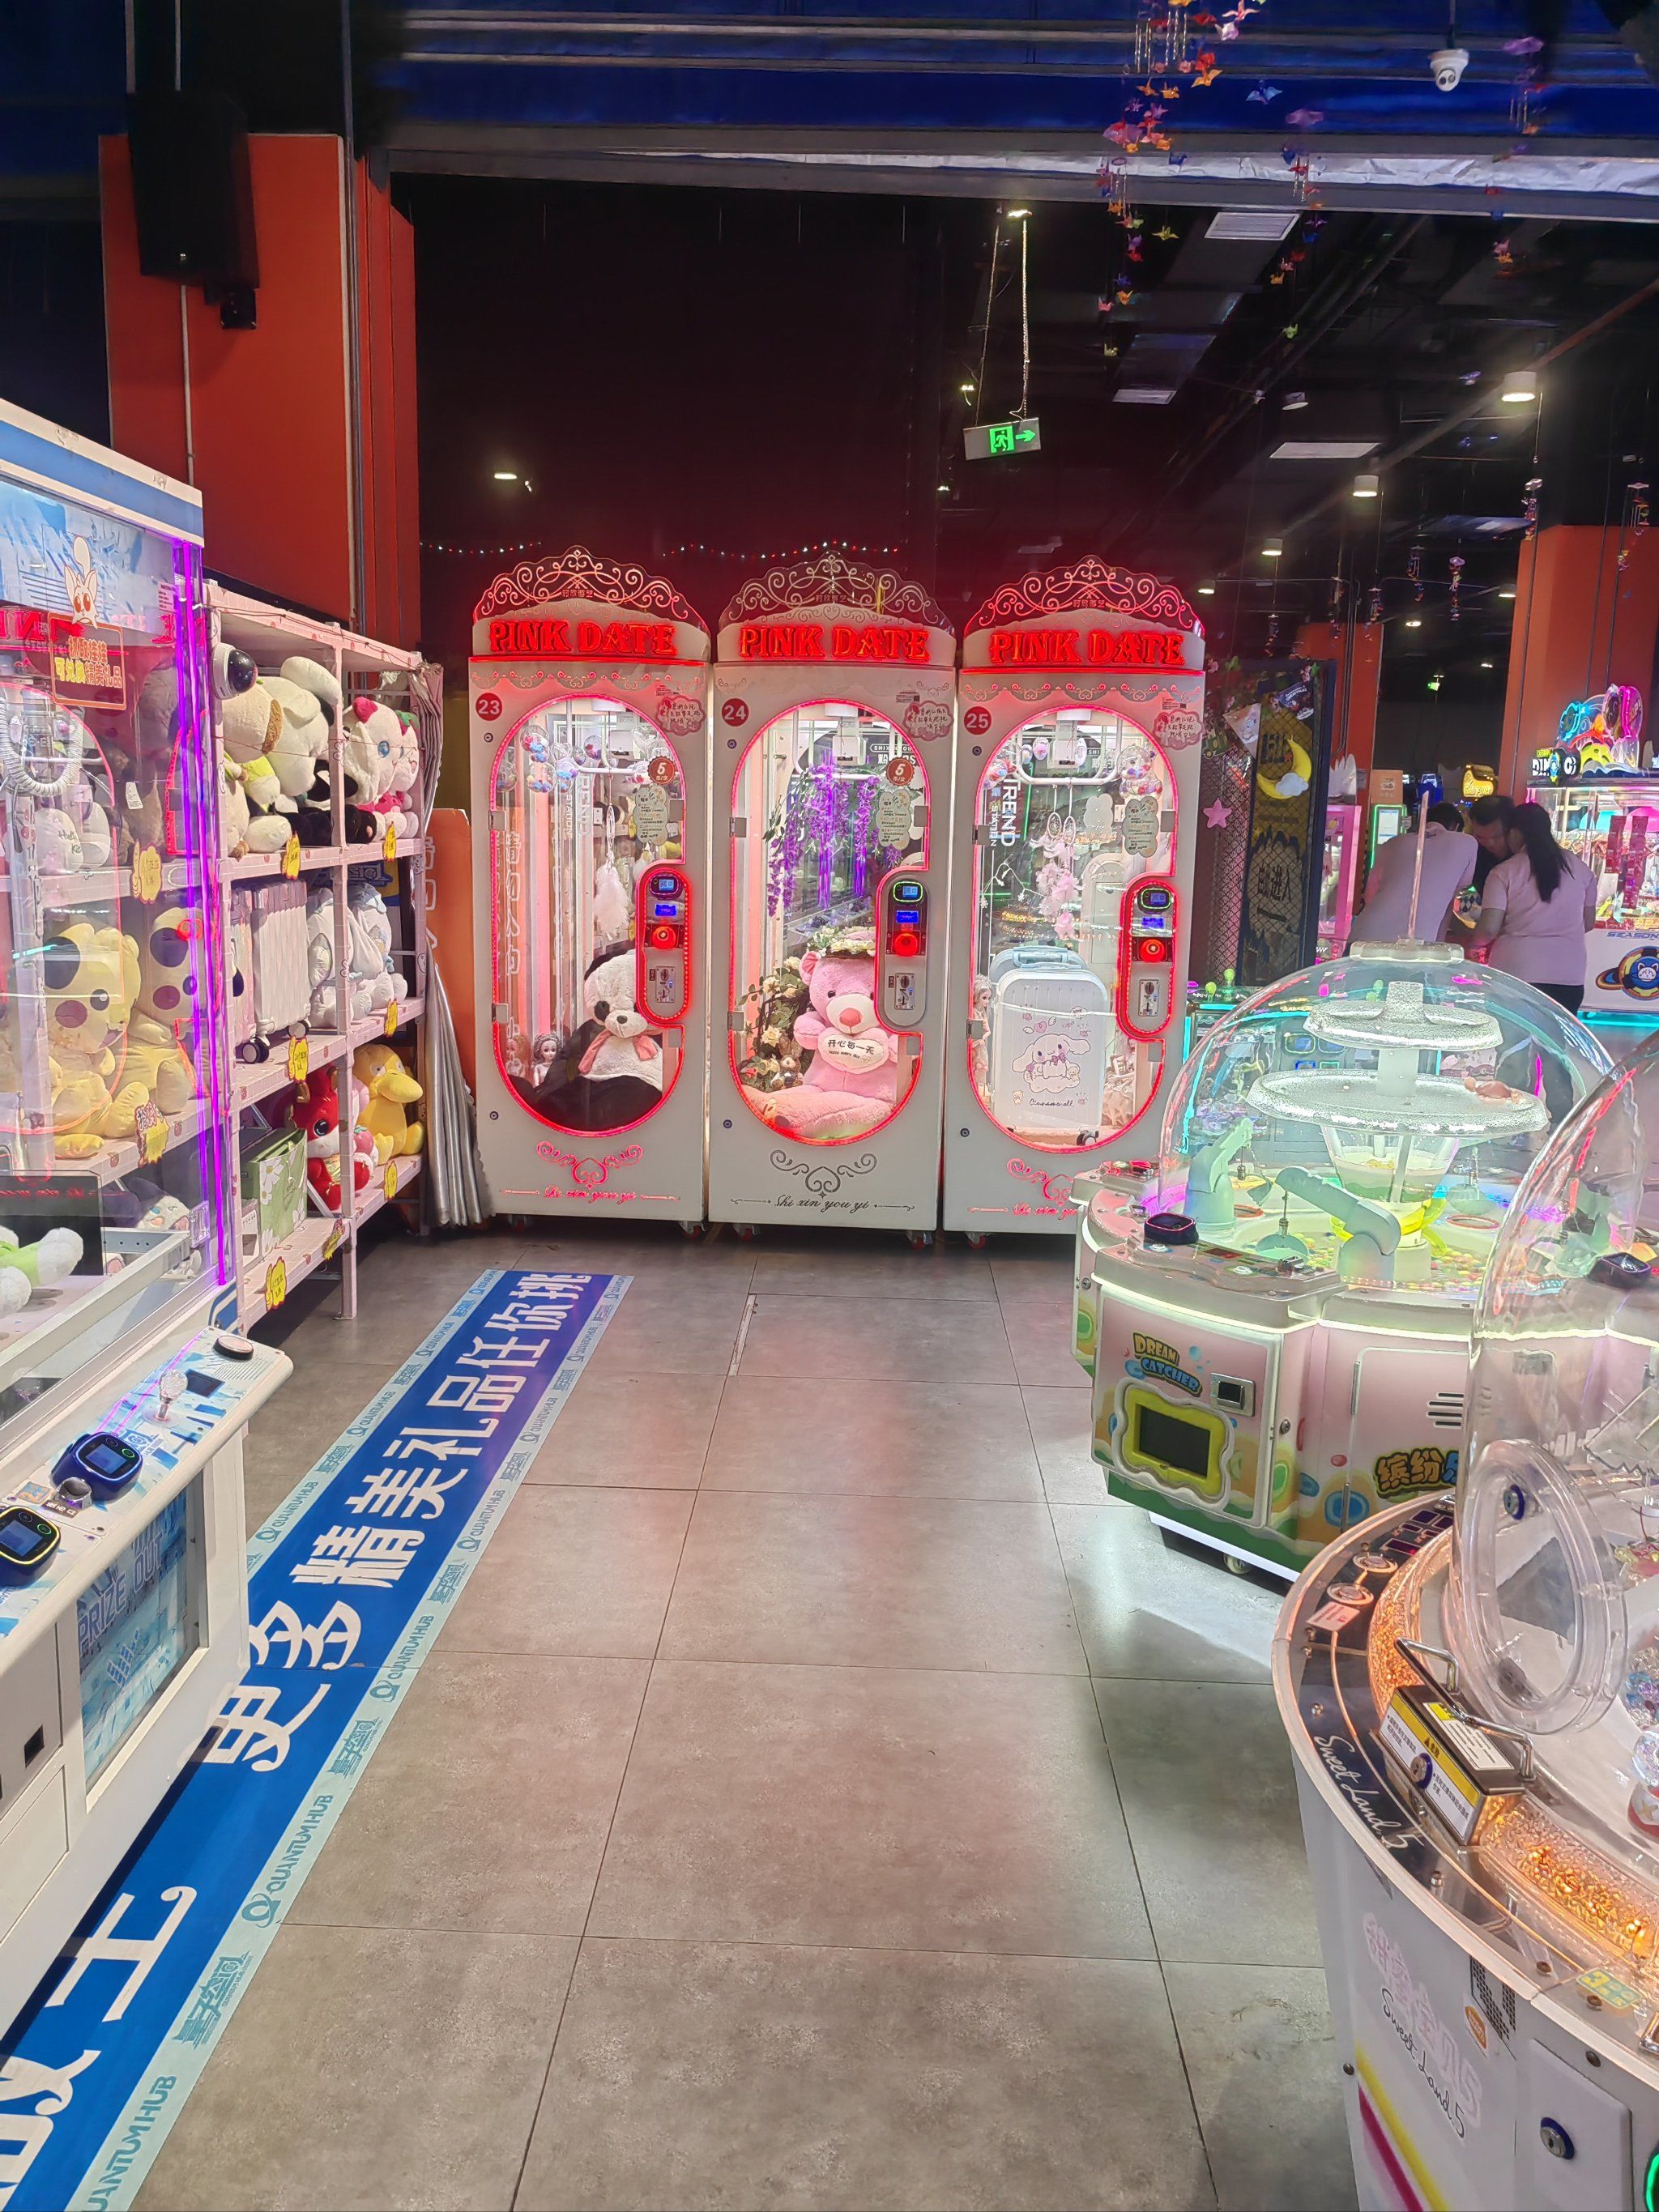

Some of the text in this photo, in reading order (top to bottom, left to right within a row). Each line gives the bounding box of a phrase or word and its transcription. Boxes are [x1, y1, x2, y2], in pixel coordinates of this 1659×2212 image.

[489, 621, 679, 656] PINK DATE
[740, 625, 931, 662] PINK DATE
[992, 631, 1186, 667] PINK DATE
[53, 656, 122, 689] 可兑换精美礼品
[479, 699, 500, 715] 23
[724, 705, 746, 721] 24
[966, 713, 989, 729] 25
[657, 762, 666, 775] 5
[895, 763, 905, 776] 5
[828, 1039, 875, 1055] 开心每一天
[796, 1199, 821, 1208] xin
[820, 1200, 850, 1213] you
[849, 1200, 869, 1213] yi
[1141, 1357, 1201, 1392] CATCHER
[203, 1274, 591, 1772] 更多精美礼品任你挑
[78, 1532, 163, 1647] PRIZE OUT
[1314, 1736, 1361, 1784] Sweet
[1341, 1783, 1401, 1832] Land
[1382, 1988, 1465, 2139] Sweet Land 5
